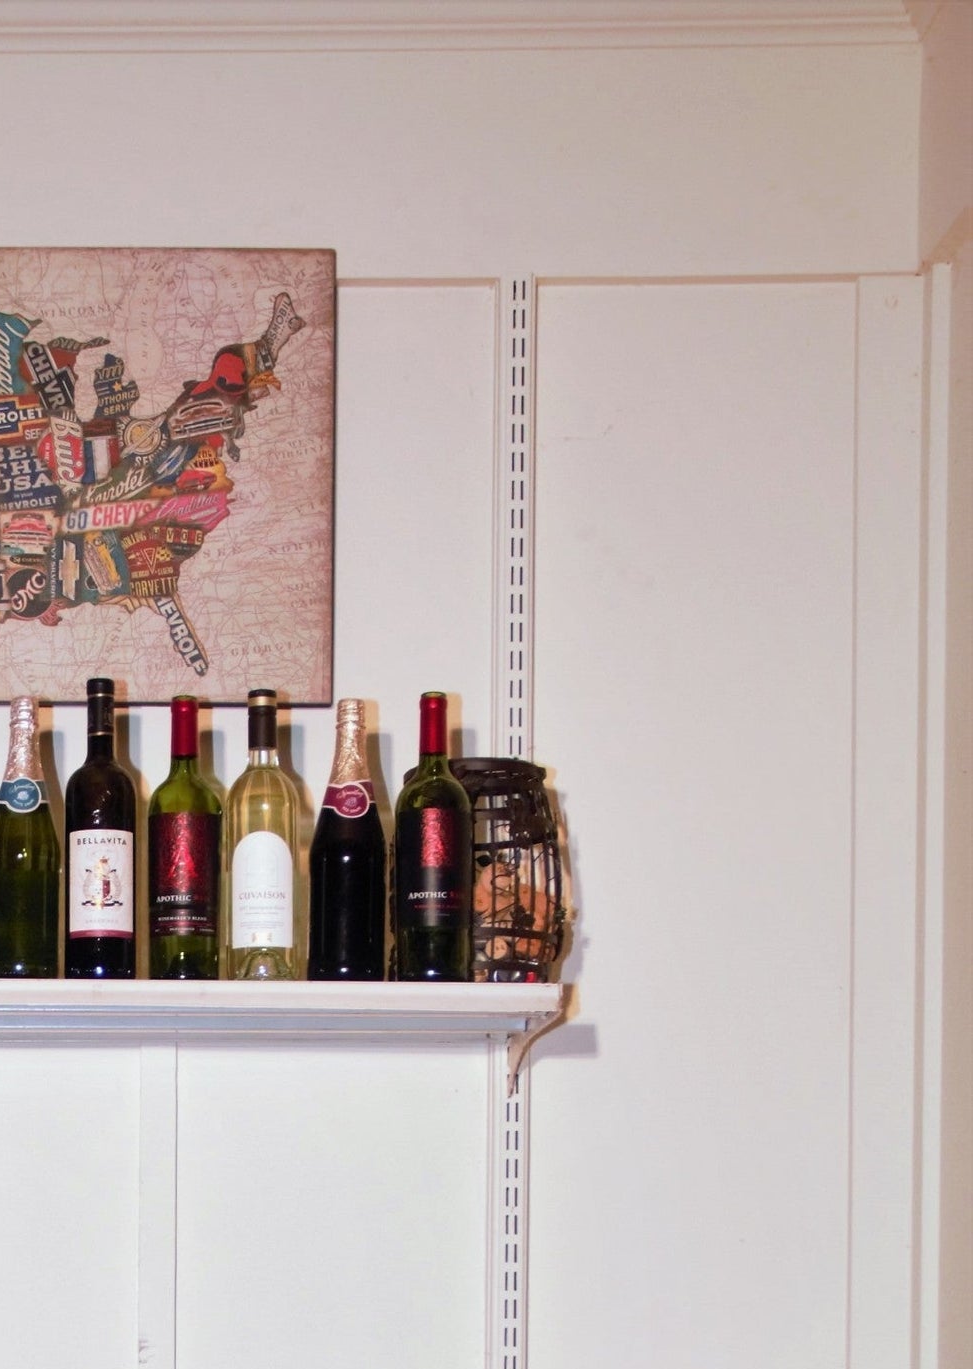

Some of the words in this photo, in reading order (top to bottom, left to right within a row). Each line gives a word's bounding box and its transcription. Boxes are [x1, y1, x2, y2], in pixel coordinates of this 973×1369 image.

[11, 572, 46, 612] GMC
[77, 837, 127, 846] BELLAVITA
[156, 894, 192, 903] APOTHIC
[408, 890, 447, 900] APOTHIC
